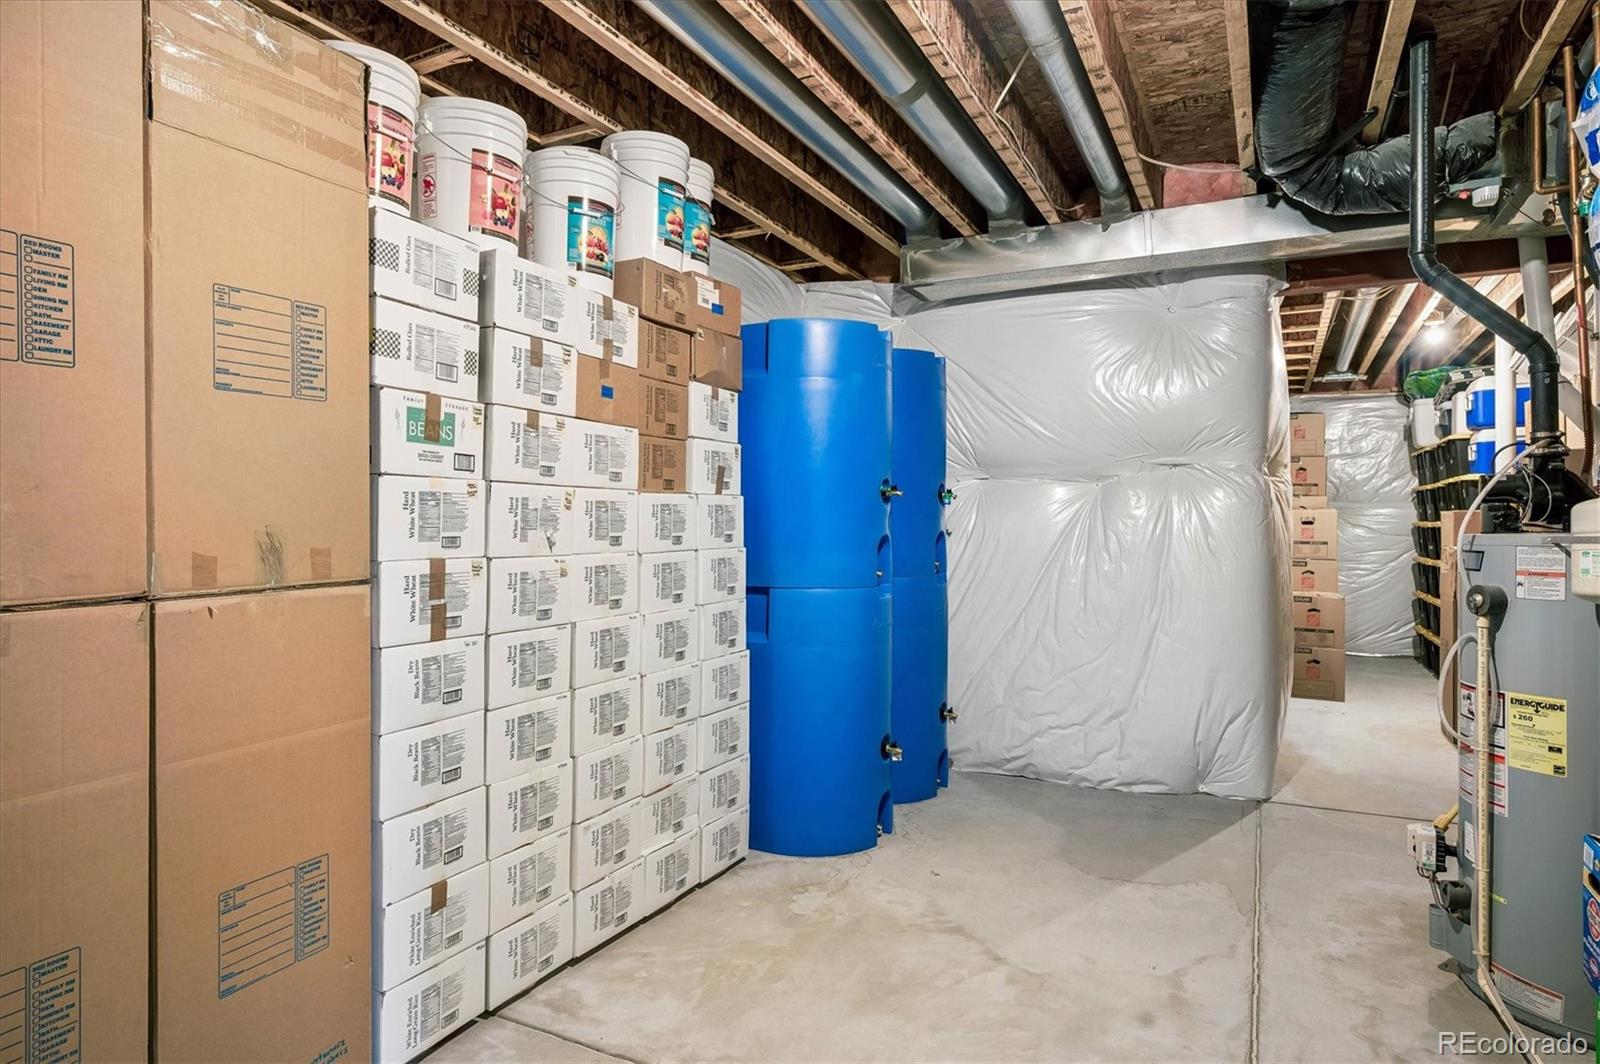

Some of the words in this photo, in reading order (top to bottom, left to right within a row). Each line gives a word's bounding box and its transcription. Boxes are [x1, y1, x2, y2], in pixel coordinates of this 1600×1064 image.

[24, 239, 38, 247] BED
[38, 242, 62, 252] ROOMS
[32, 249, 60, 259] MASTER
[33, 269, 56, 278] FAMILY
[33, 278, 56, 287] LIVING
[33, 295, 56, 304] DINING
[33, 304, 63, 313] KITCHEN
[34, 320, 69, 330] BASEMENT
[34, 329, 61, 337] GARAGE
[409, 420, 453, 440] BEANS
[1510, 698, 1565, 712] ENERGYGUIDE
